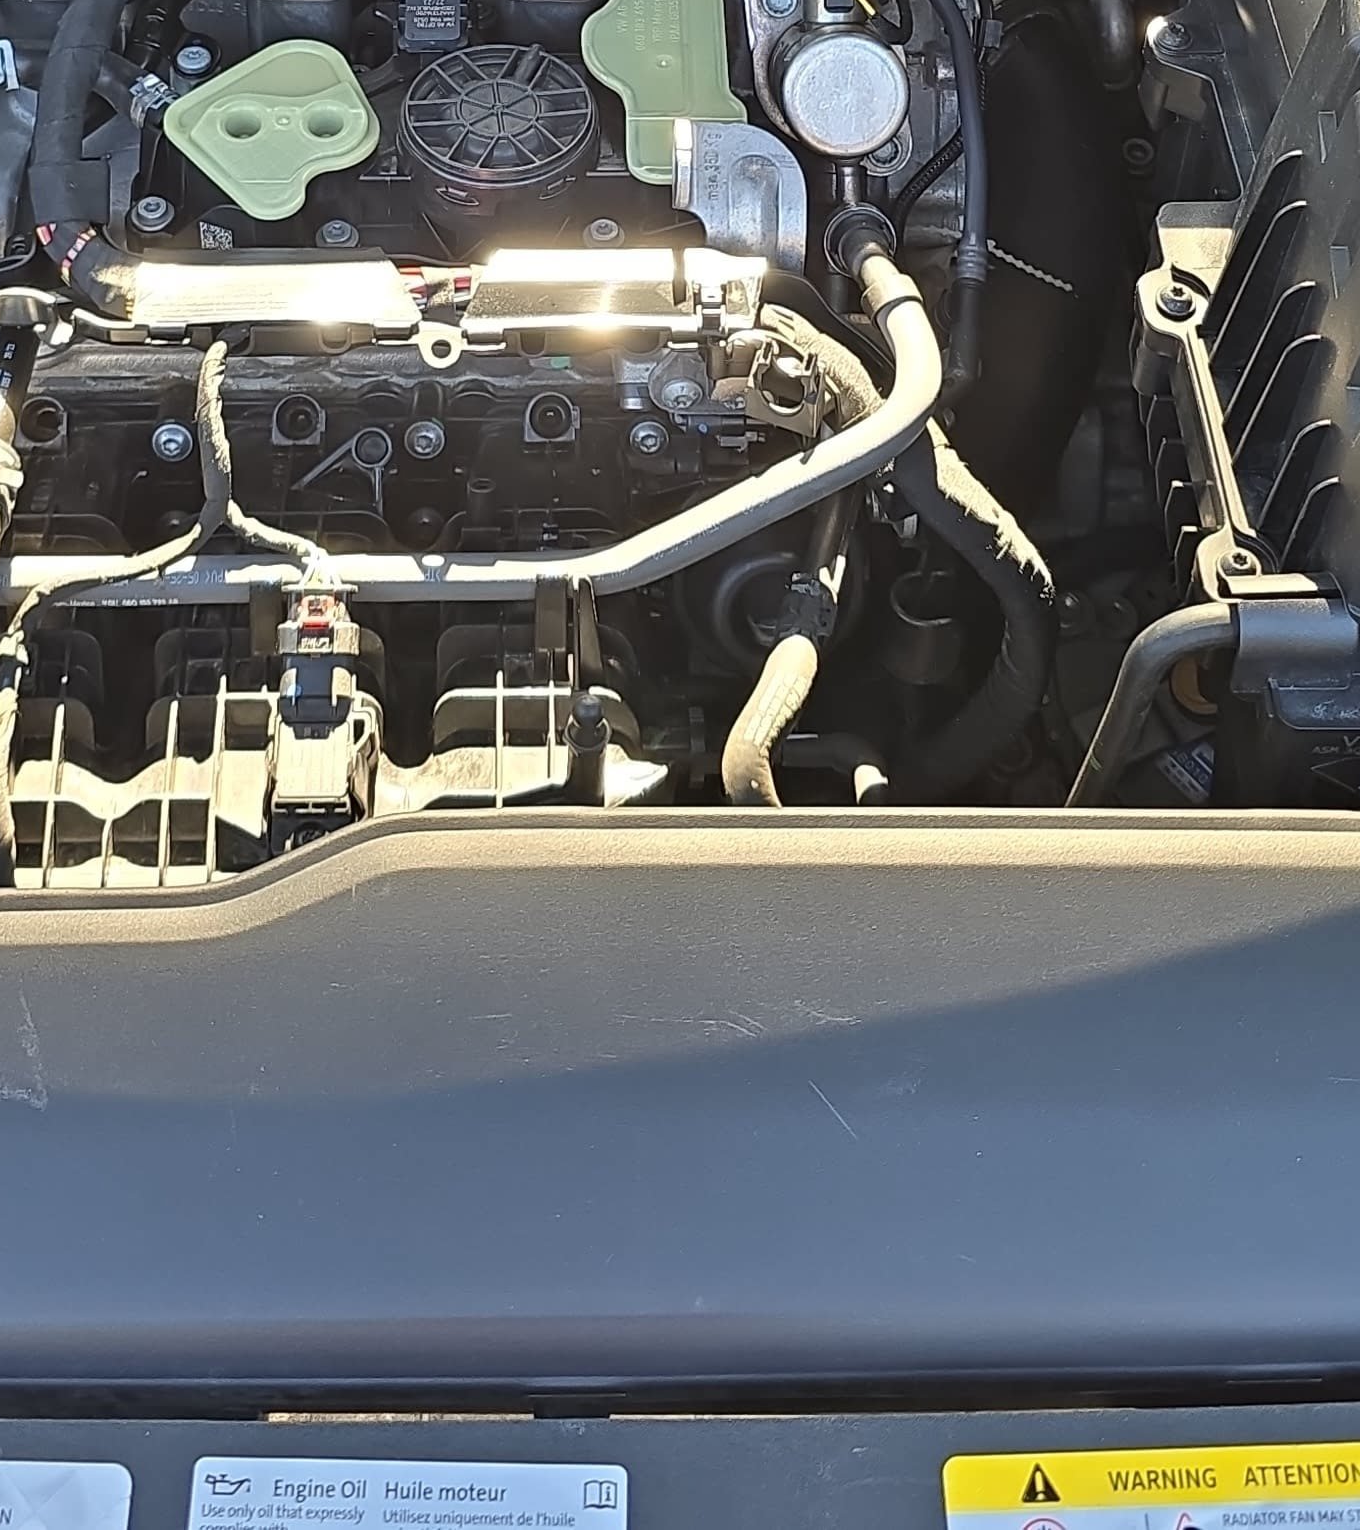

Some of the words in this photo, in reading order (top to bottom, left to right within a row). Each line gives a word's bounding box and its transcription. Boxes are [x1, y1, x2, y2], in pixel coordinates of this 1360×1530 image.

[1108, 1468, 1218, 1491] WARNING
[273, 1479, 336, 1503] Engine
[341, 1480, 367, 1498] Oil
[384, 1481, 433, 1501] Huile
[439, 1482, 507, 1503] moteur
[201, 1504, 226, 1518] Use
[228, 1505, 255, 1520] only
[257, 1506, 273, 1519] oil
[276, 1506, 303, 1519] that
[305, 1508, 365, 1524] expressly
[383, 1510, 430, 1524] Utilisez
[434, 1512, 513, 1529] uniquement
[517, 1513, 533, 1526] de
[537, 1512, 576, 1527] l'huile
[1222, 1511, 1287, 1526] RADIATOR
[1291, 1510, 1314, 1523] FAN
[1316, 1510, 1343, 1522] MAY
